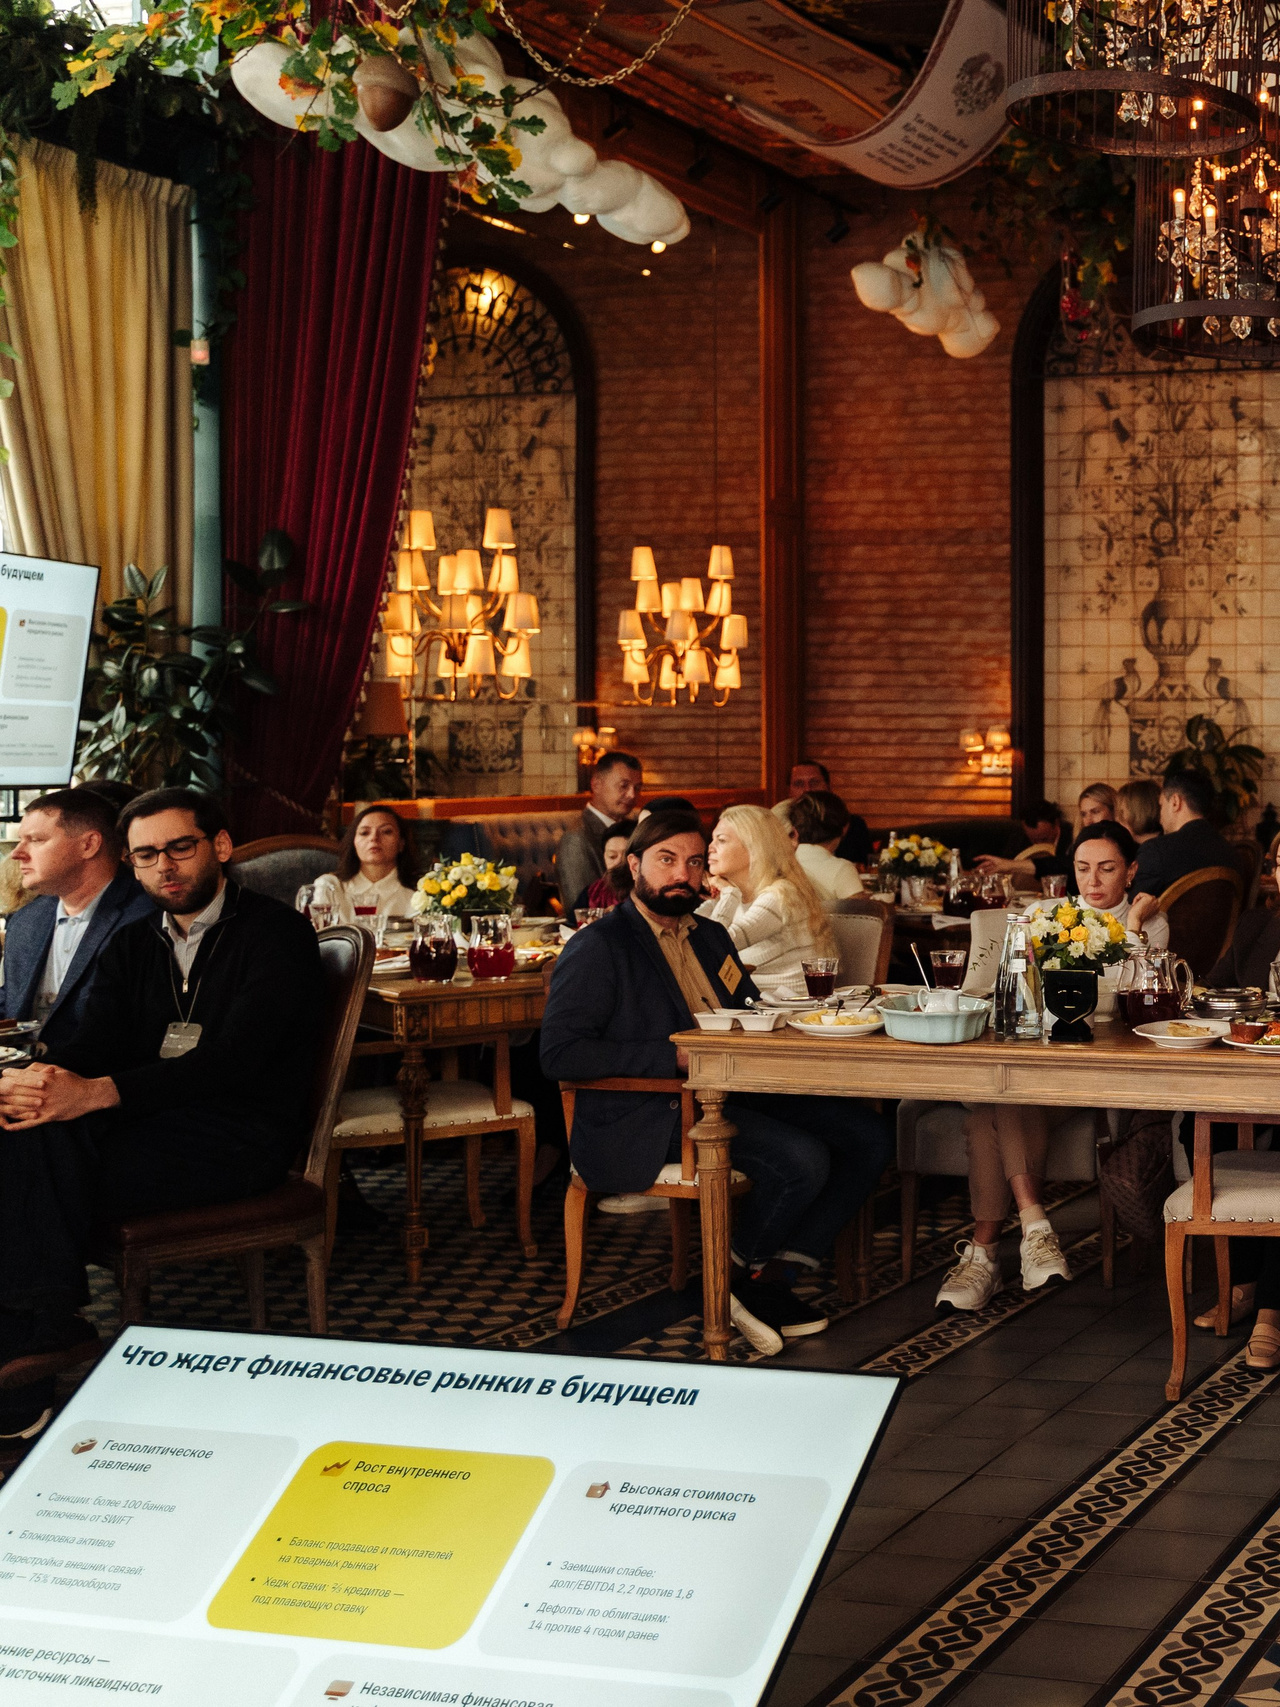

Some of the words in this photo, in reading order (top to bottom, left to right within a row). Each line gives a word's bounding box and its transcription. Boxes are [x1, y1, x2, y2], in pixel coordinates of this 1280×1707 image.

[1, 564, 44, 581] будущем
[121, 1344, 168, 1367] Что
[169, 1352, 247, 1373] ждет
[247, 1354, 433, 1386] финансовые
[431, 1370, 537, 1393] рынки
[536, 1378, 557, 1395] в
[560, 1375, 700, 1406] будущем
[102, 1439, 214, 1460] Геополитическое
[88, 1458, 152, 1473] давление
[354, 1460, 386, 1474] Рост
[386, 1464, 471, 1481] внутреннего
[343, 1480, 391, 1494] спроса
[619, 1481, 680, 1498] Высокая
[682, 1488, 756, 1504] стоимость
[48, 1492, 92, 1505] Санкции:
[93, 1495, 121, 1508] более
[123, 1499, 142, 1509] 100
[142, 1501, 176, 1513] банков
[609, 1502, 691, 1518] кредитного
[692, 1508, 736, 1522] риска
[36, 1509, 88, 1522] отключены
[89, 1514, 101, 1523] от
[101, 1514, 134, 1526] SWIFT
[19, 1530, 75, 1544] Блокировка
[76, 1537, 116, 1549] активов
[288, 1536, 326, 1549] Баланс
[325, 1541, 380, 1555] продавцов
[381, 1547, 389, 1555] и
[389, 1546, 454, 1561] покупателей
[2, 1552, 63, 1568] Перестройка
[64, 1560, 108, 1572] внешних
[108, 1564, 145, 1576] связей:
[278, 1554, 291, 1563] на
[293, 1556, 340, 1568] товарных
[340, 1561, 380, 1572] рынках
[560, 1560, 615, 1576] Заемщики
[616, 1566, 656, 1578] слабее:
[50, 1576, 122, 1591] товарооборота
[263, 1577, 290, 1589] Хедж
[291, 1580, 330, 1592] ставки:
[343, 1586, 391, 1598] кредитов
[550, 1578, 615, 1593] долг/EBITDA
[616, 1584, 635, 1596] 2,2
[635, 1587, 674, 1600] против
[675, 1588, 694, 1601] 1,8
[251, 1595, 272, 1606] под
[272, 1596, 332, 1611] плавающую
[333, 1603, 369, 1616] ставку
[536, 1602, 584, 1617] Дефолты
[585, 1608, 600, 1619] по
[601, 1608, 670, 1624] облигациям:
[528, 1620, 543, 1631] 14
[543, 1621, 582, 1635] против
[583, 1625, 591, 1635] 4
[592, 1627, 625, 1640] годом
[626, 1630, 660, 1641] ранее
[32, 1648, 95, 1665] ресурсы
[5, 1667, 73, 1684] источник
[70, 1674, 163, 1695] ликвидности
[360, 1681, 459, 1704] Независимая
